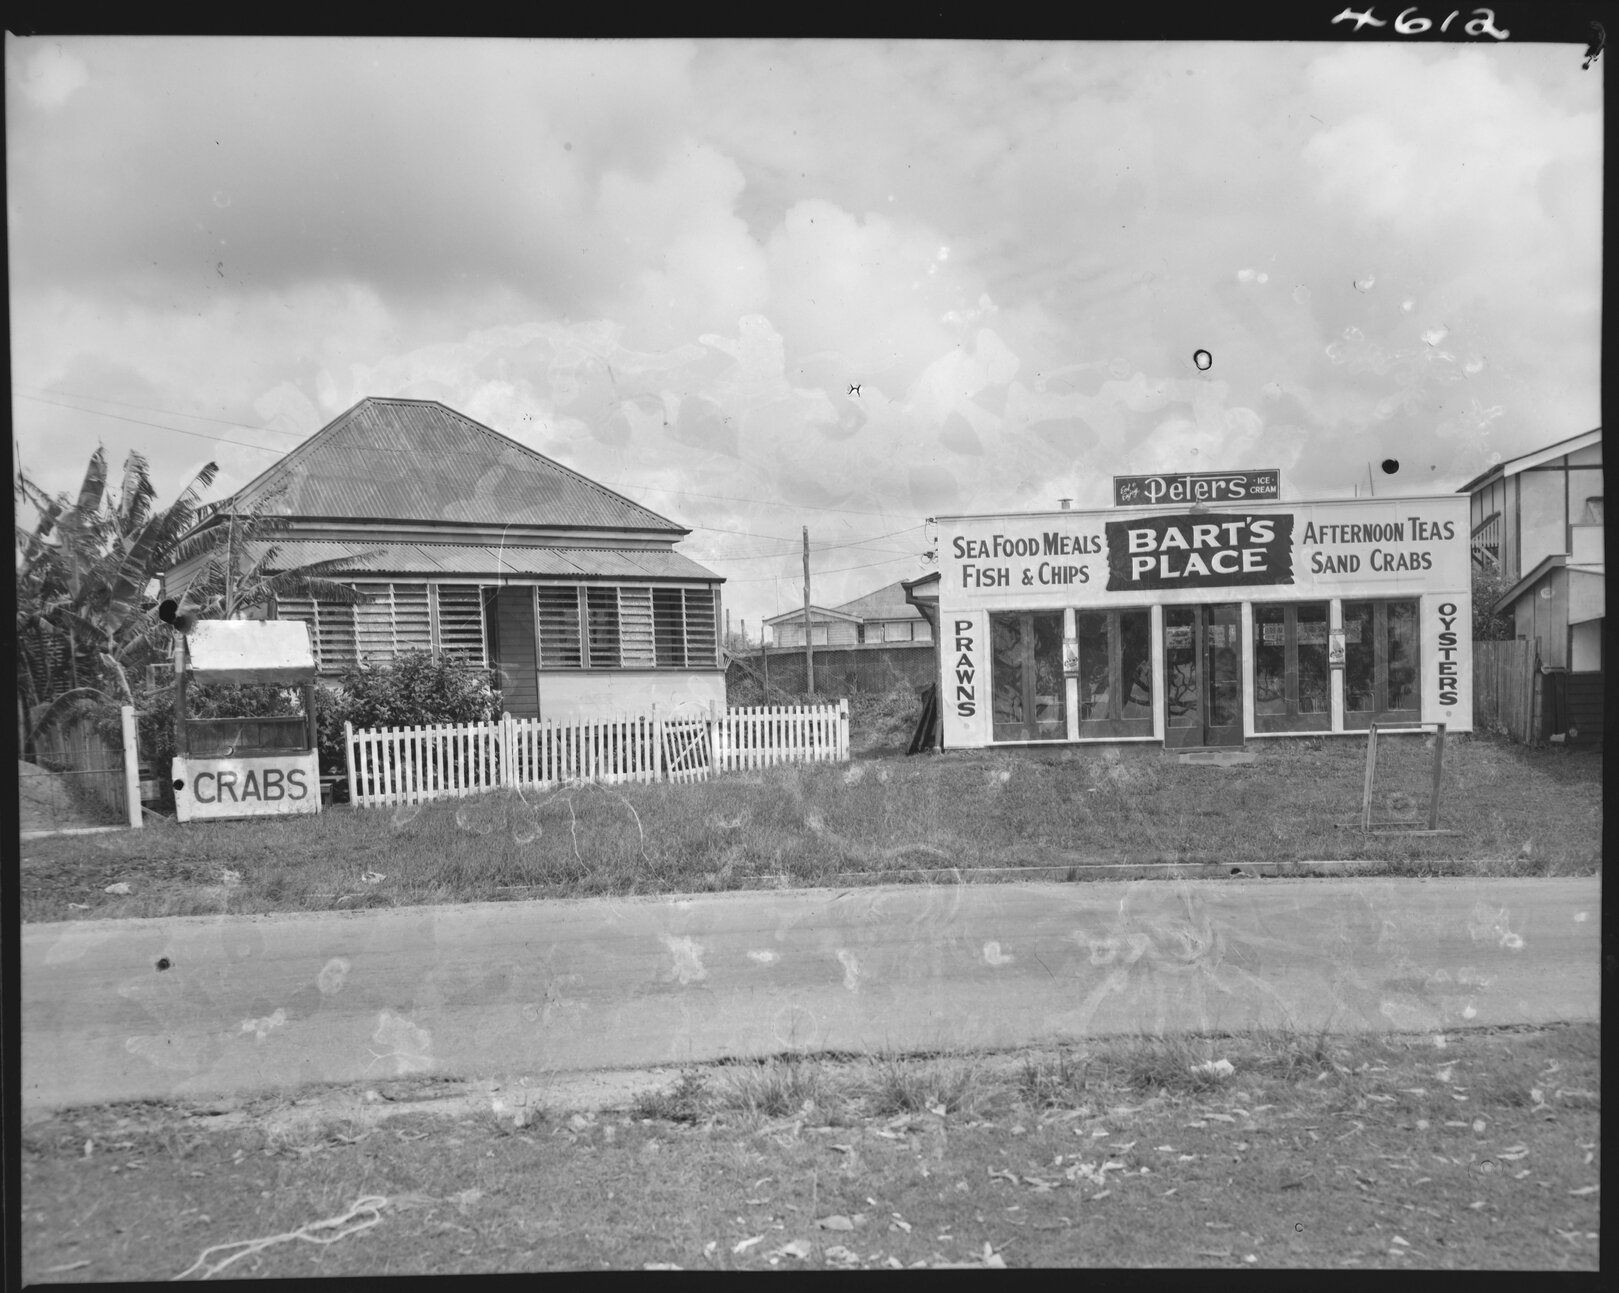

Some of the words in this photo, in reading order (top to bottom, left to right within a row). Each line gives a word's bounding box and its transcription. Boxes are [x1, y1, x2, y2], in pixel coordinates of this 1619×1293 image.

[1331, 6, 1511, 40] 4612
[1144, 476, 1247, 504] Peters
[1250, 485, 1277, 494] CREAM
[1257, 476, 1270, 485] ICE
[1043, 532, 1102, 556] MEALS
[1128, 517, 1275, 554] BART'S
[1303, 521, 1404, 545] AFTERNOON
[1408, 517, 1455, 541] TEAS
[962, 564, 1010, 588] FISH
[1022, 568, 1034, 586] &
[1038, 561, 1090, 585] CHIPS
[1131, 547, 1268, 582] PLACE
[1311, 551, 1361, 574] SAND
[1370, 549, 1433, 572] CRABS
[1438, 602, 1458, 706] OYSTERS
[954, 620, 976, 717] PRAWNS
[193, 769, 308, 804] CRABS
